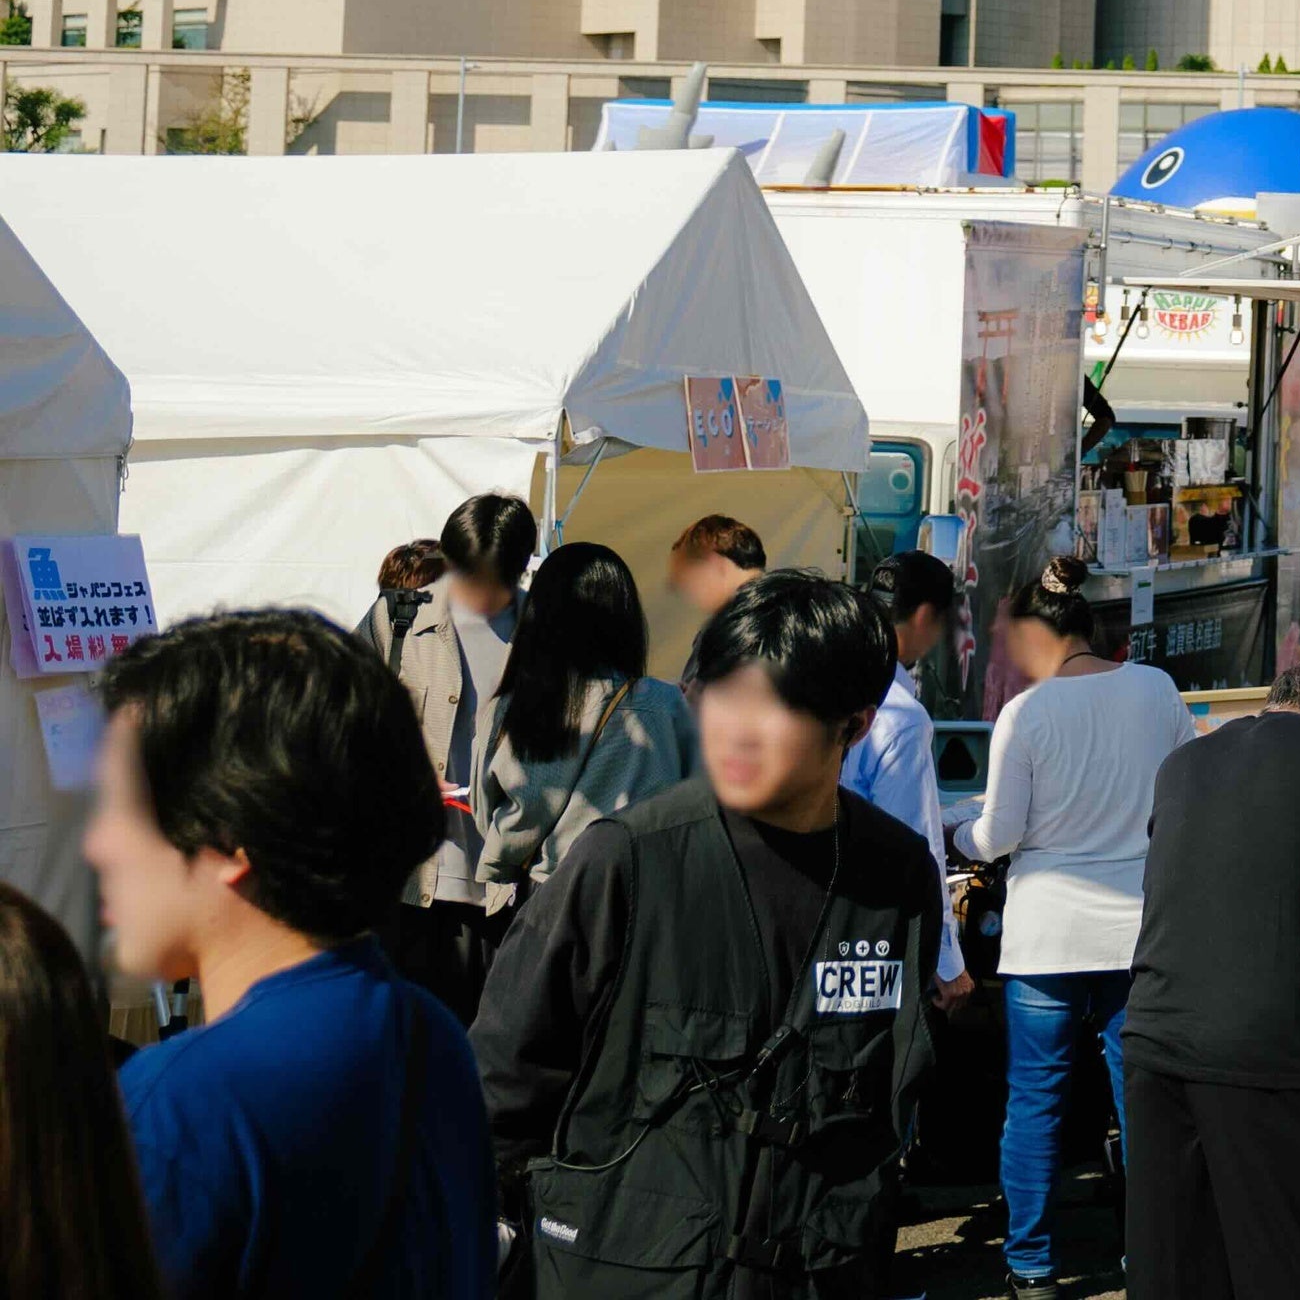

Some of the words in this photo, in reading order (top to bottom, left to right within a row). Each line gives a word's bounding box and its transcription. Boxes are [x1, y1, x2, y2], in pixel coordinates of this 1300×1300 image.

[66, 581, 147, 599] ジャパンフェス
[820, 964, 900, 998] CREW
